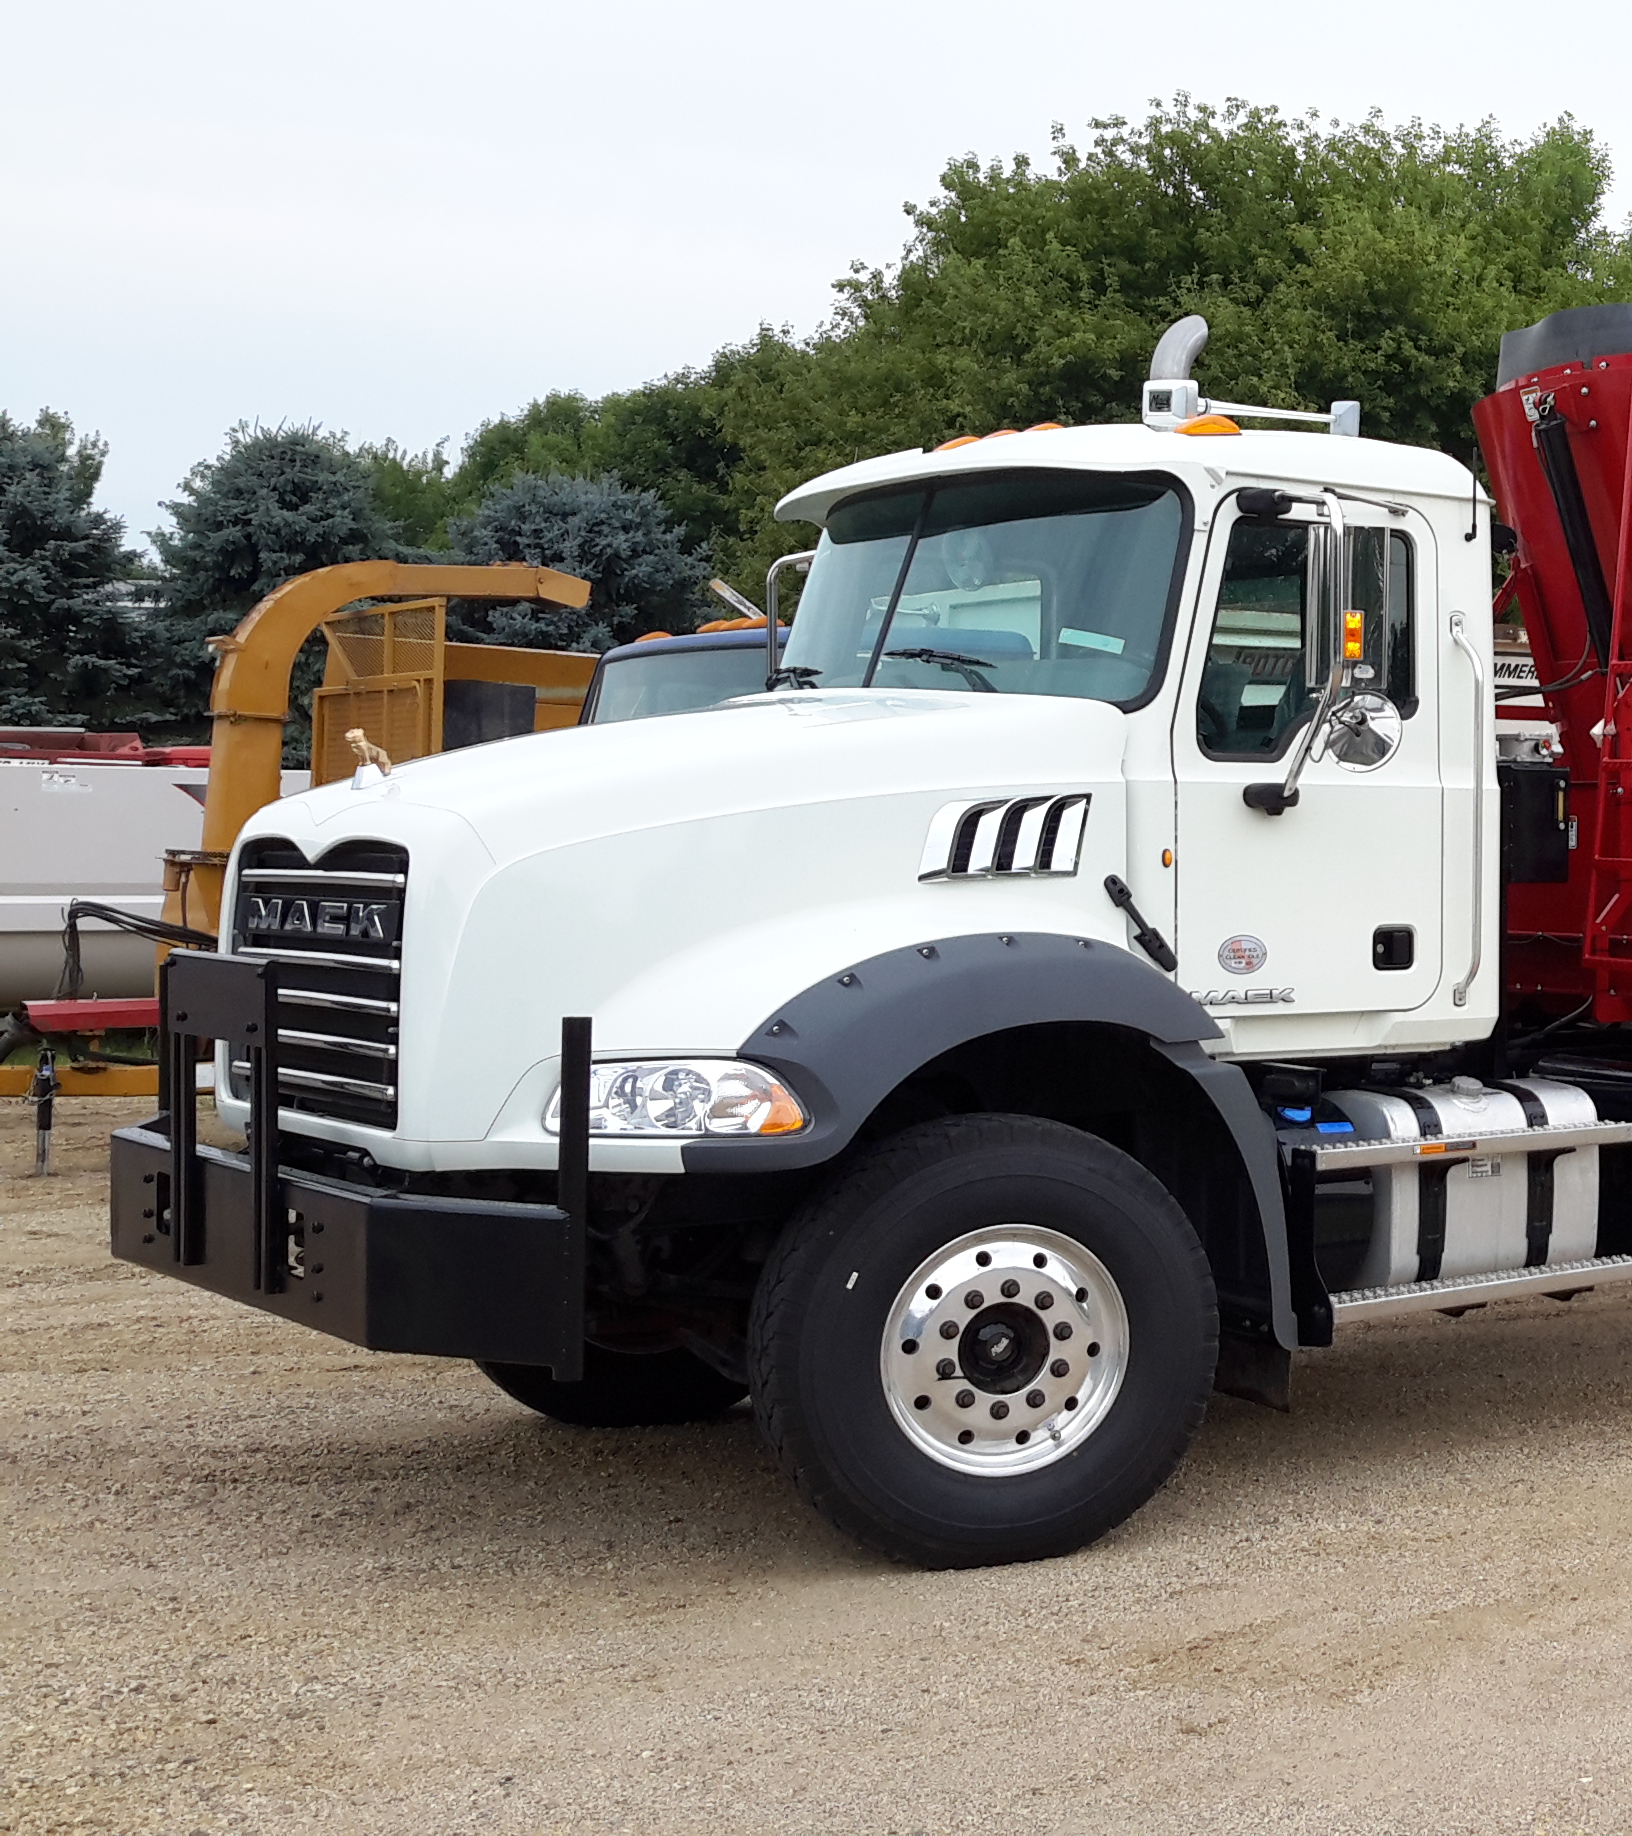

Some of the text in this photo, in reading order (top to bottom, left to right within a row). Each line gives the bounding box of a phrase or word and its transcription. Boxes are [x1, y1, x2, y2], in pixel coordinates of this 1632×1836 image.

[1494, 662, 1538, 680] MMER
[248, 898, 387, 939] MACK
[1190, 987, 1295, 1005] MACK
